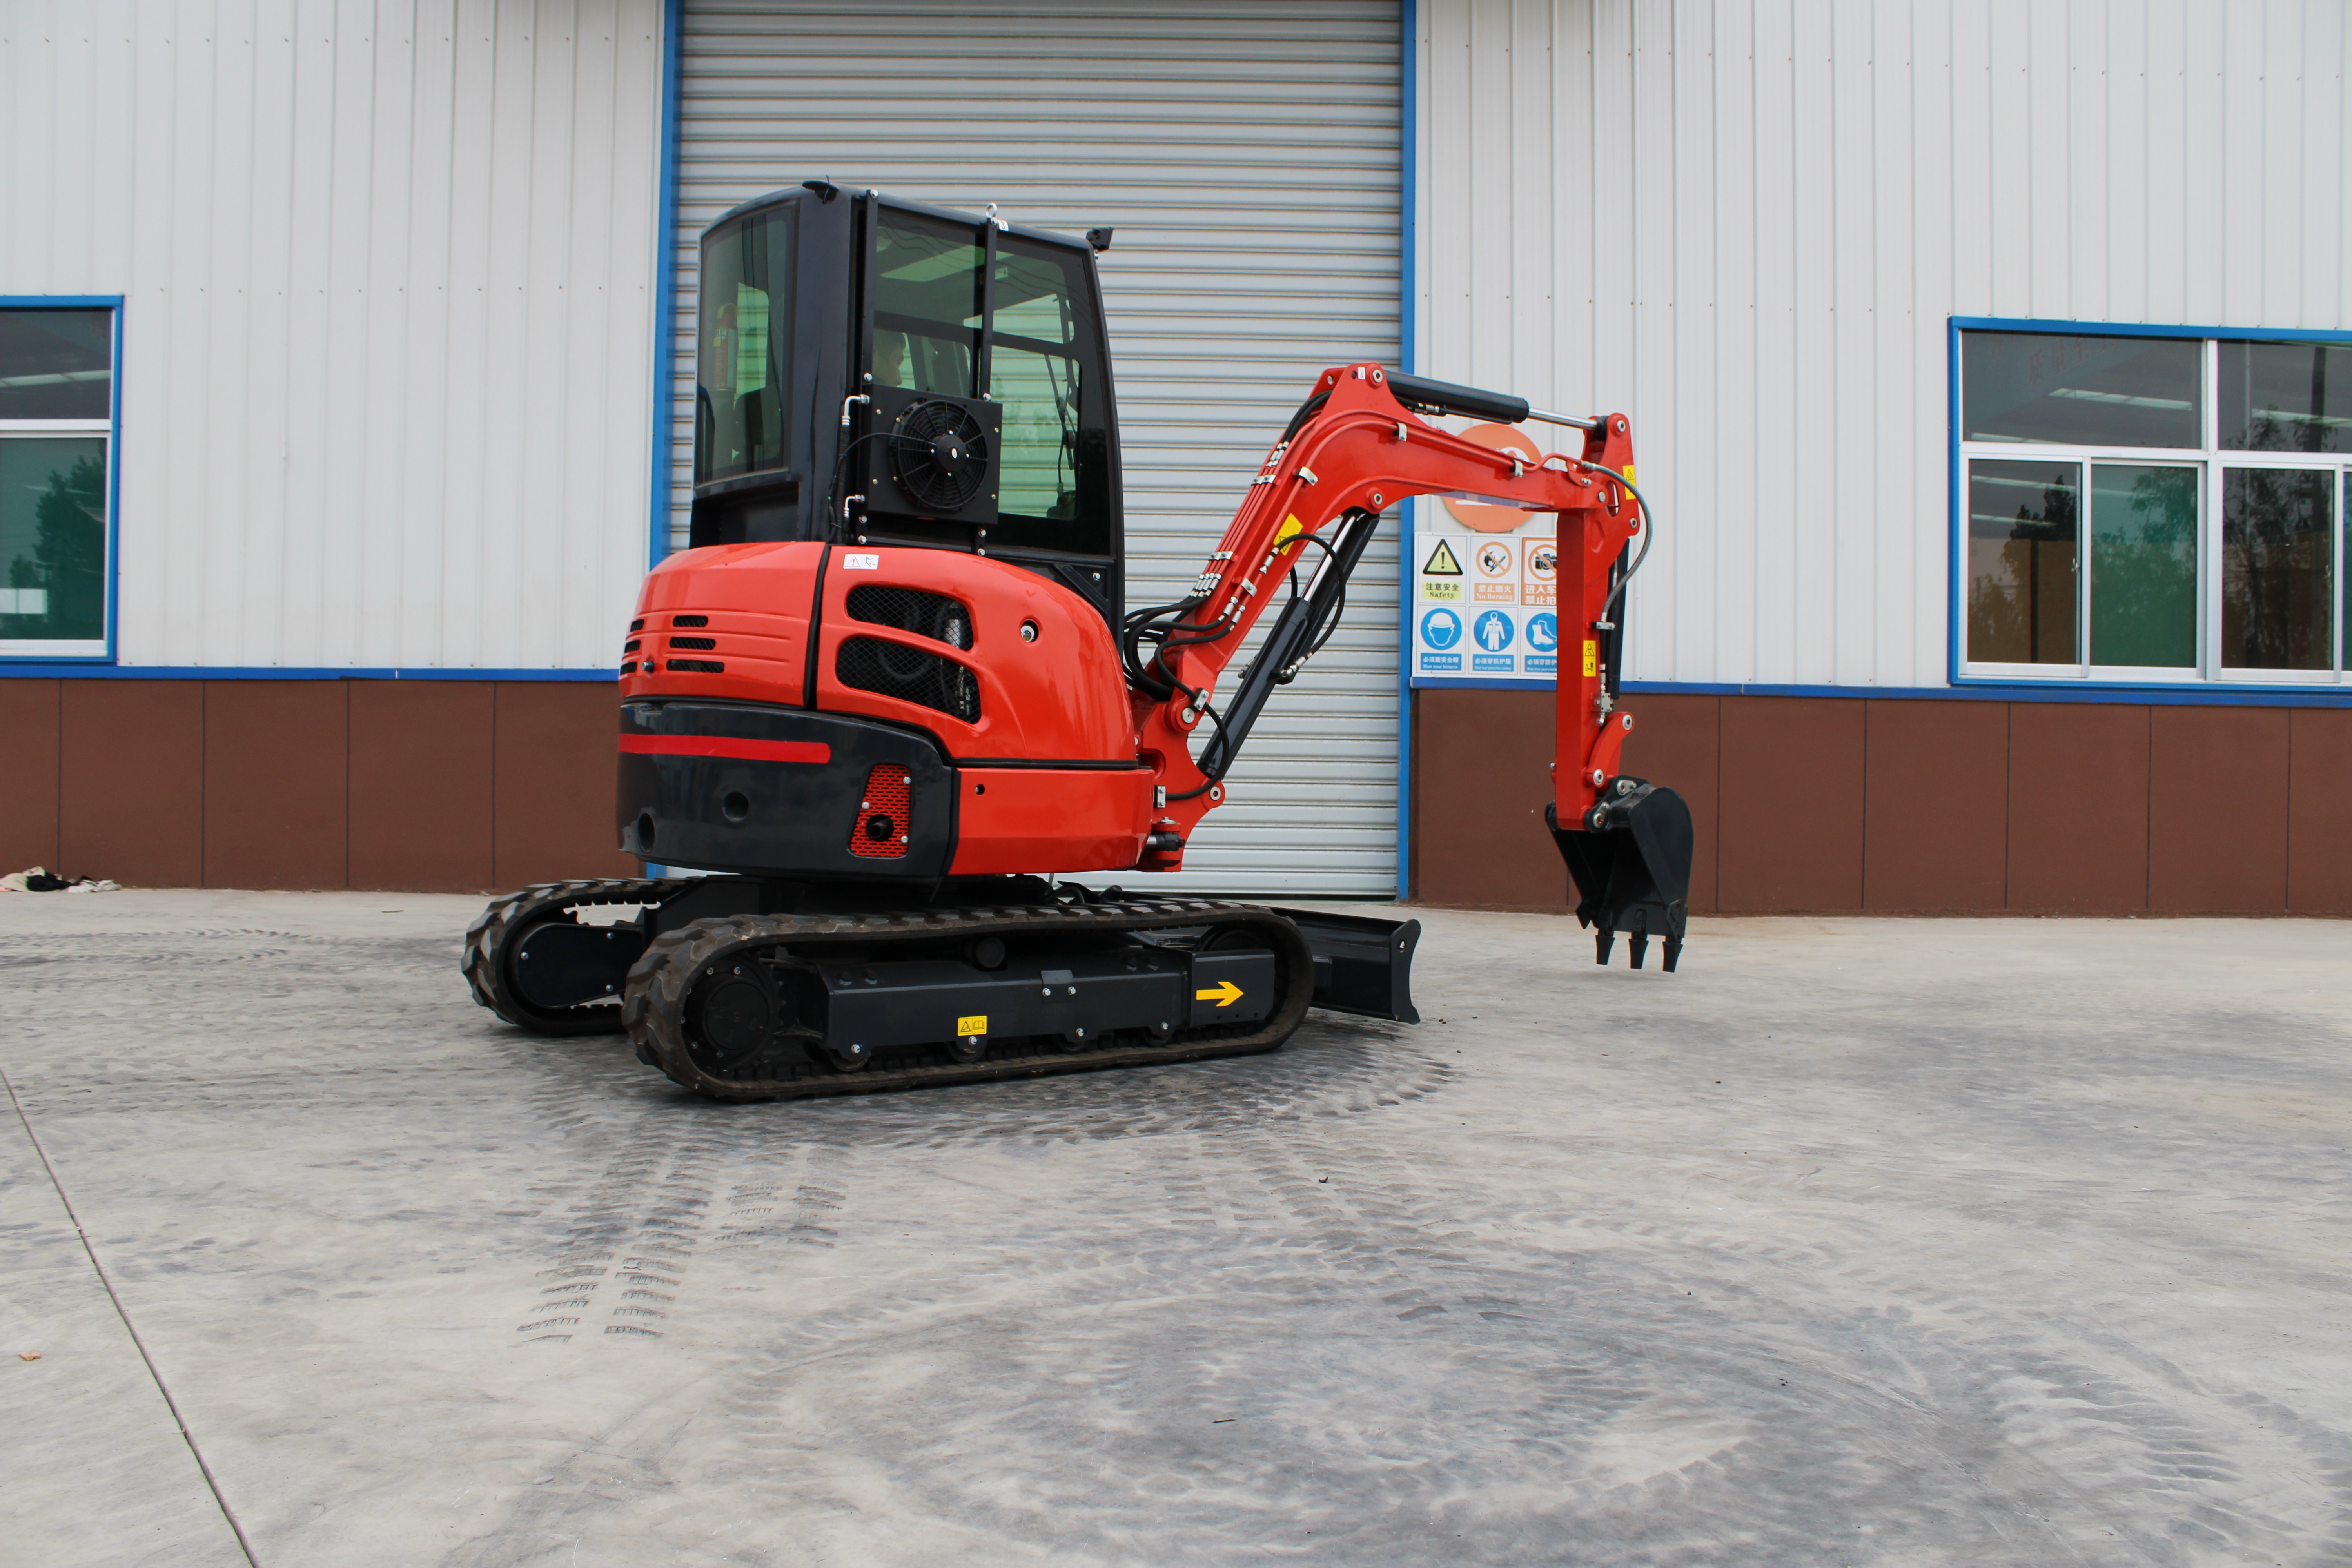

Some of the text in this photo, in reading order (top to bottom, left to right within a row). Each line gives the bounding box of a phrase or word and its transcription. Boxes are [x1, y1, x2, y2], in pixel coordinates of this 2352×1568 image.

[1426, 583, 1459, 591] 注意安全
[1478, 585, 1512, 593] 禁止烟火
[1525, 585, 1557, 595] 进入车
[1525, 595, 1557, 605] 禁止拍
